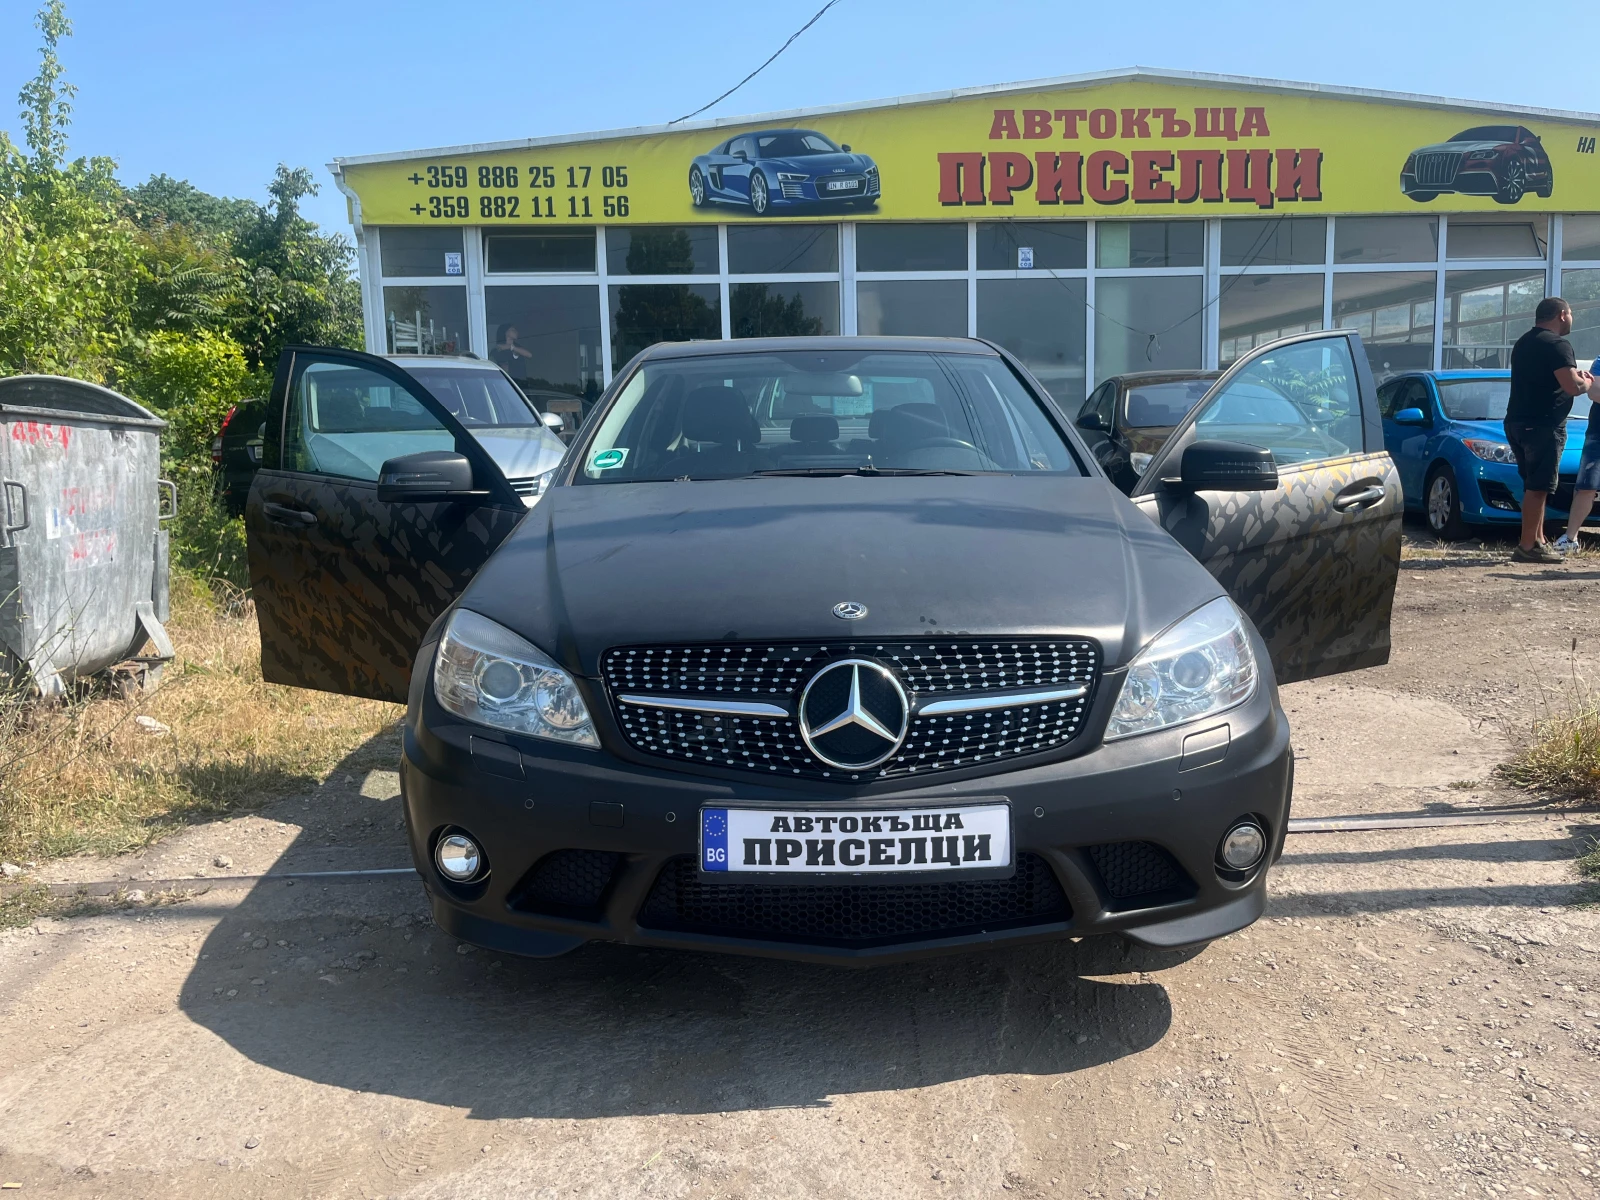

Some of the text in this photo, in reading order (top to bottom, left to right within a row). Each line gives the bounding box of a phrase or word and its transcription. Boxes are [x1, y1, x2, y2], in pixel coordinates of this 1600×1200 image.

[988, 107, 1271, 142] АВТОКЪЩА
[1576, 136, 1596, 154] НА
[408, 165, 628, 188] +359 886 25 17 05
[937, 148, 1324, 209] ПРИСЕЛЦИ
[409, 195, 629, 218] +359 882 11 11 56
[604, 451, 613, 459] 4
[769, 812, 965, 834] АВТОКЪЩА
[706, 847, 726, 863] BG
[742, 833, 992, 867] ПРИСЕЛЦИ
